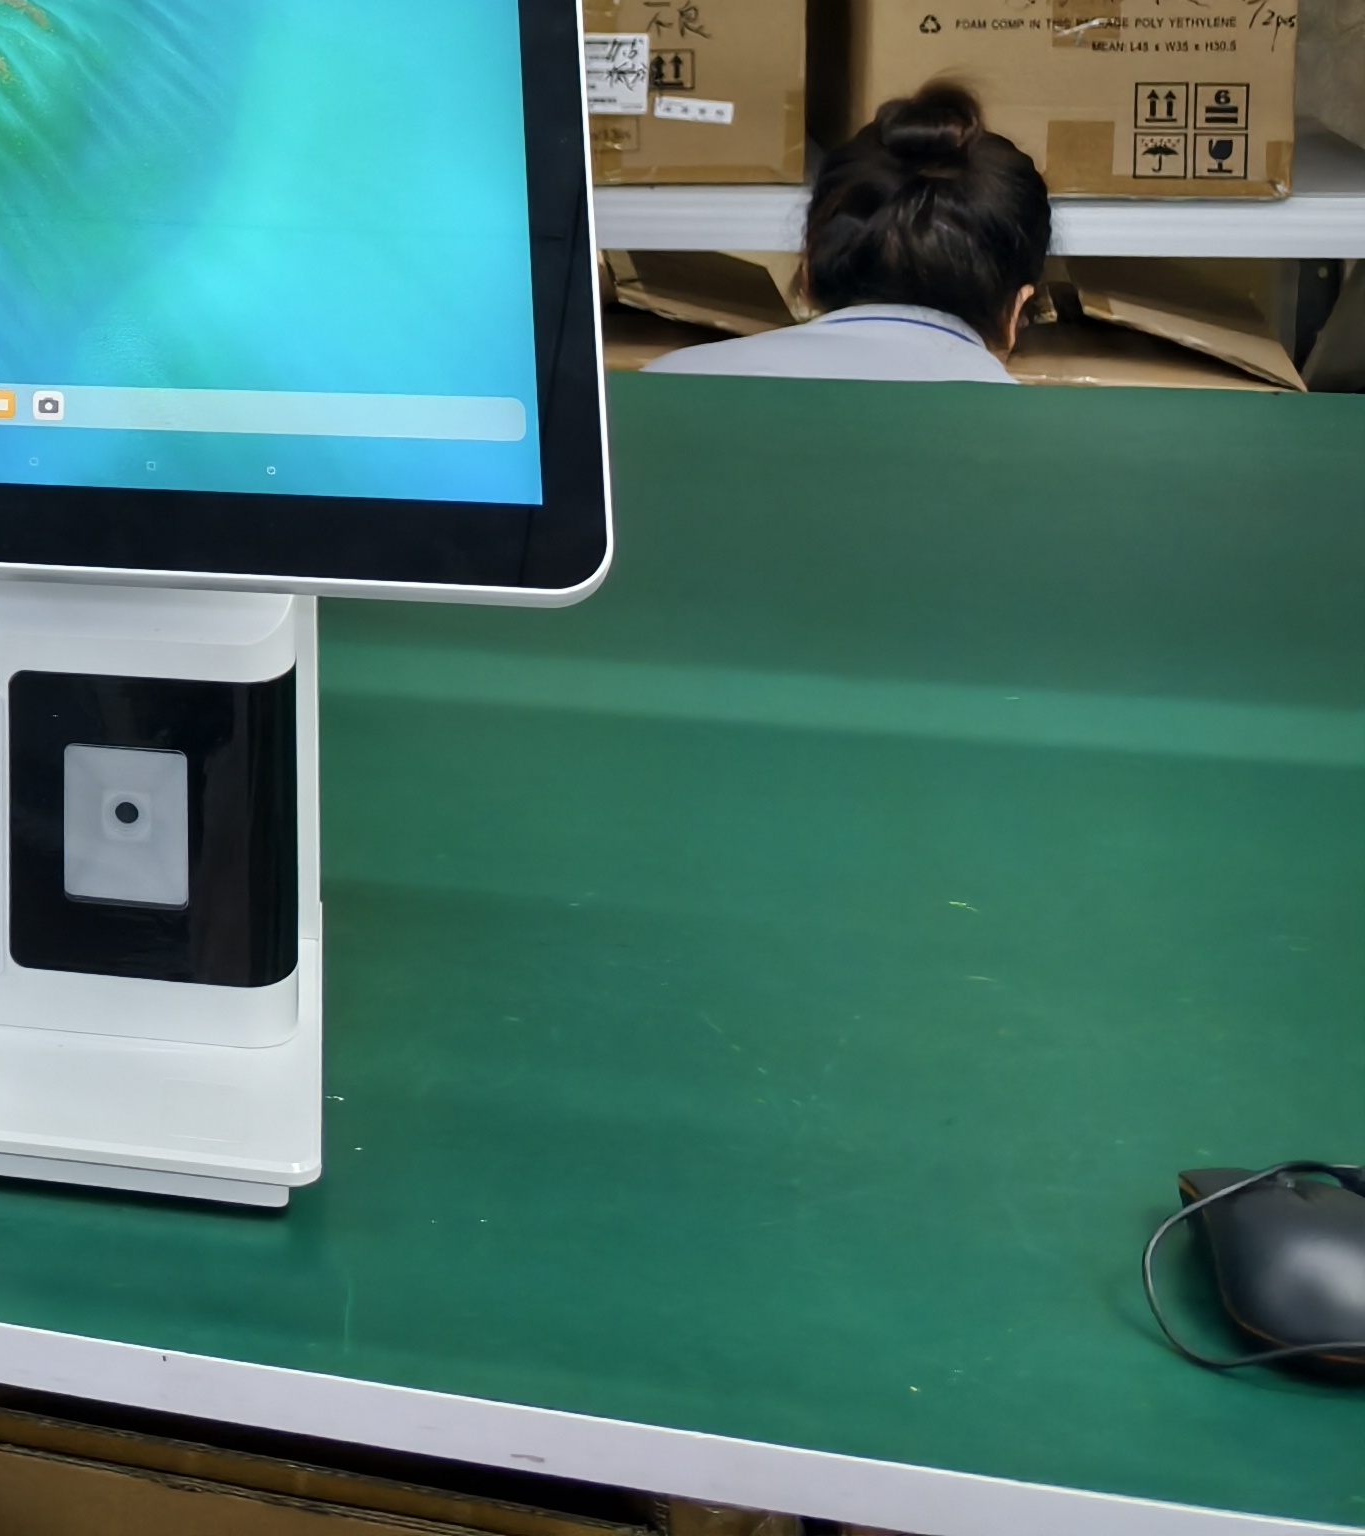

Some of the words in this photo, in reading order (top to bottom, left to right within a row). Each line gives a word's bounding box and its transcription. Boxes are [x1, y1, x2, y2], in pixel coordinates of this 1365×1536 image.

[955, 18, 987, 30] FOAM
[991, 17, 1025, 30] COMP
[1029, 17, 1041, 30] IN
[1134, 16, 1163, 29] POLY
[1214, 88, 1232, 105] 6
